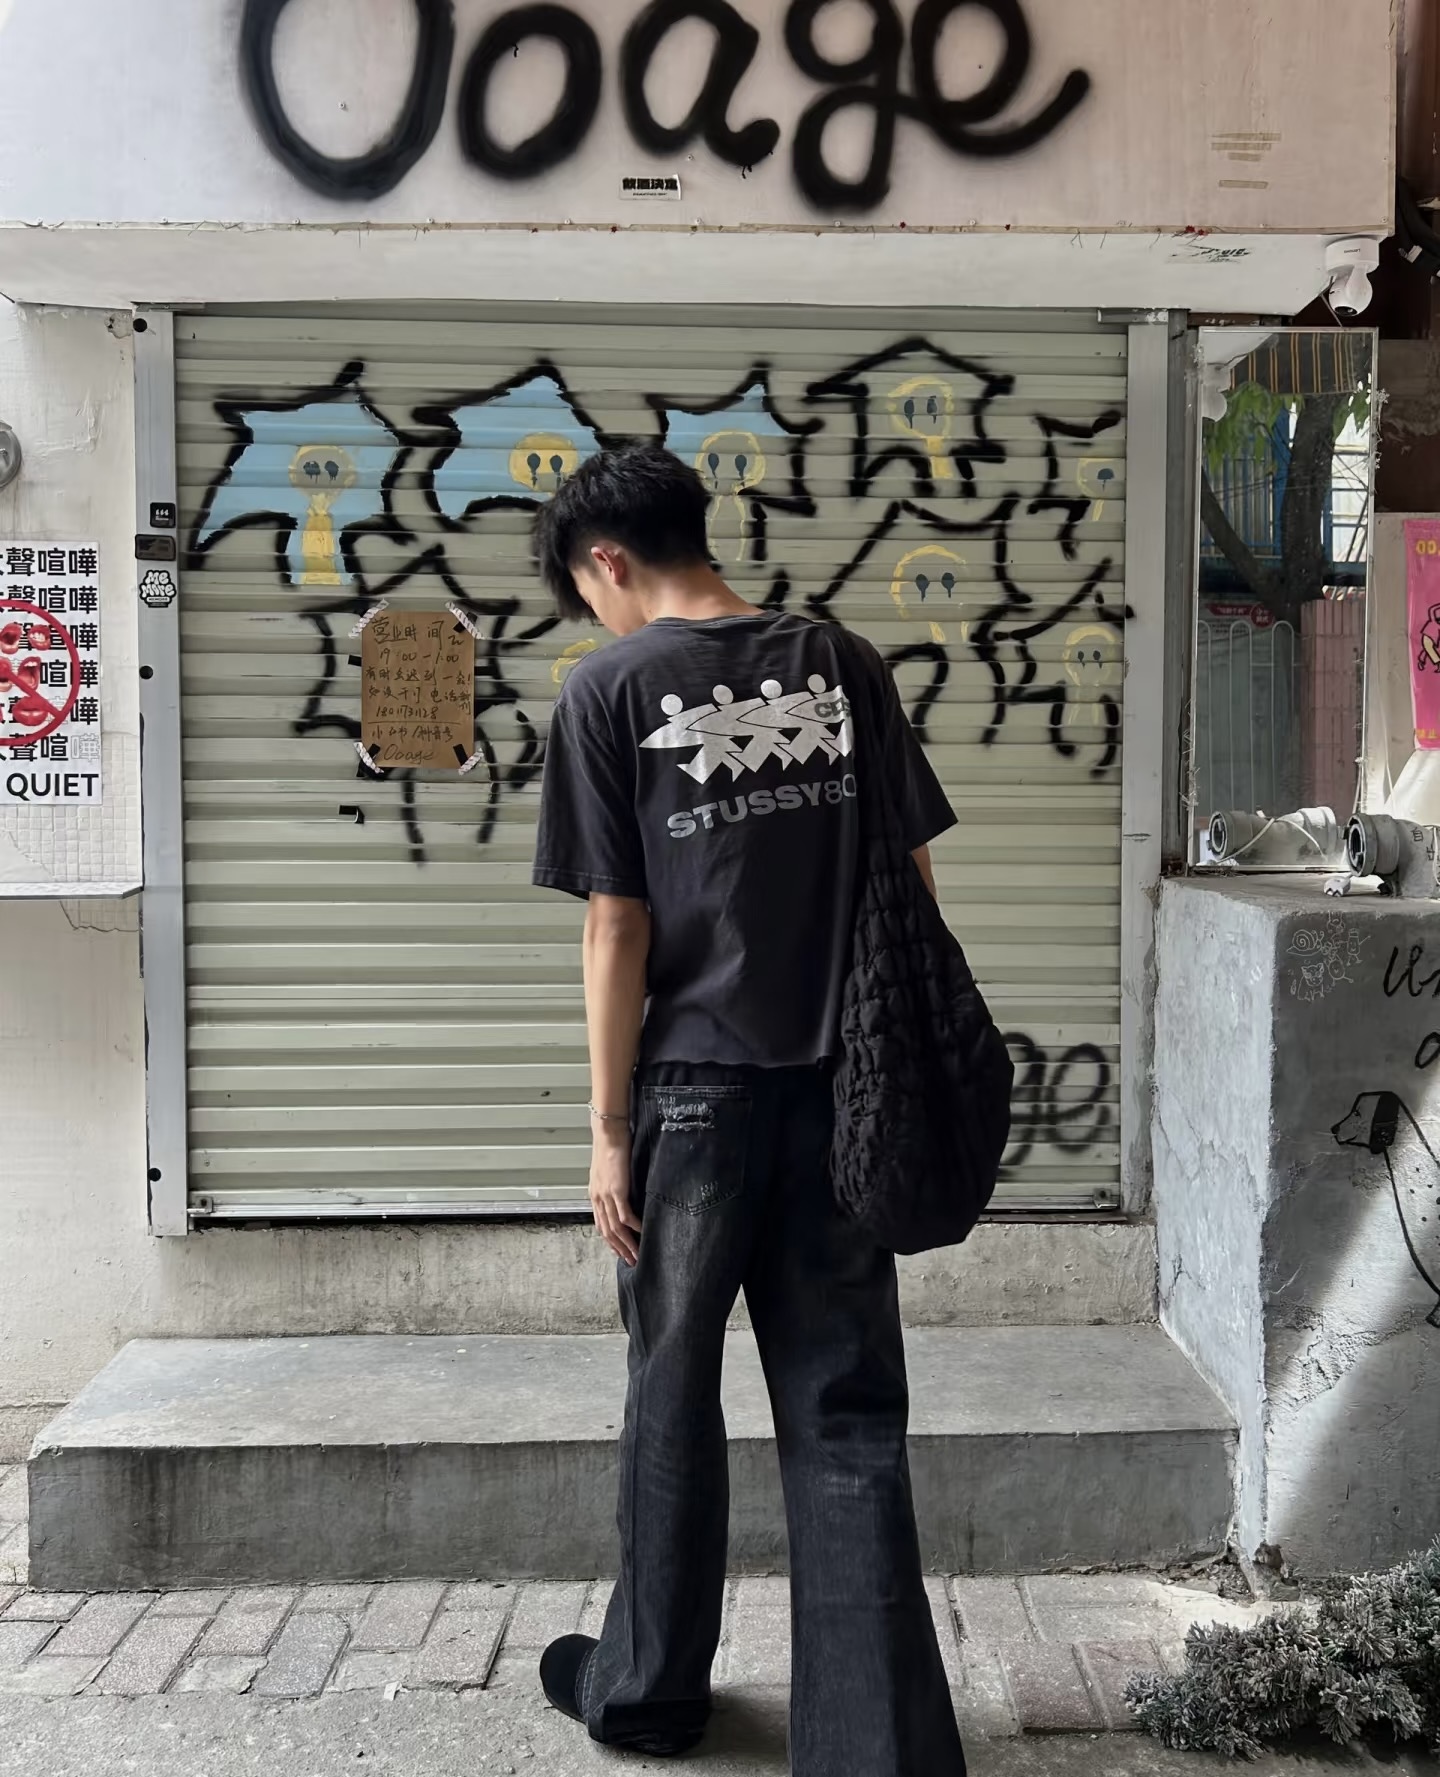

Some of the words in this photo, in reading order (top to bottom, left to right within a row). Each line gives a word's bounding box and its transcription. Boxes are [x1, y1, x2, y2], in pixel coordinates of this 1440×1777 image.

[0, 547, 97, 577] 聲喧嘩
[0, 585, 97, 614] 聲喧嘩
[0, 733, 100, 762] 聲喧嘩
[6, 772, 99, 801] QUIET
